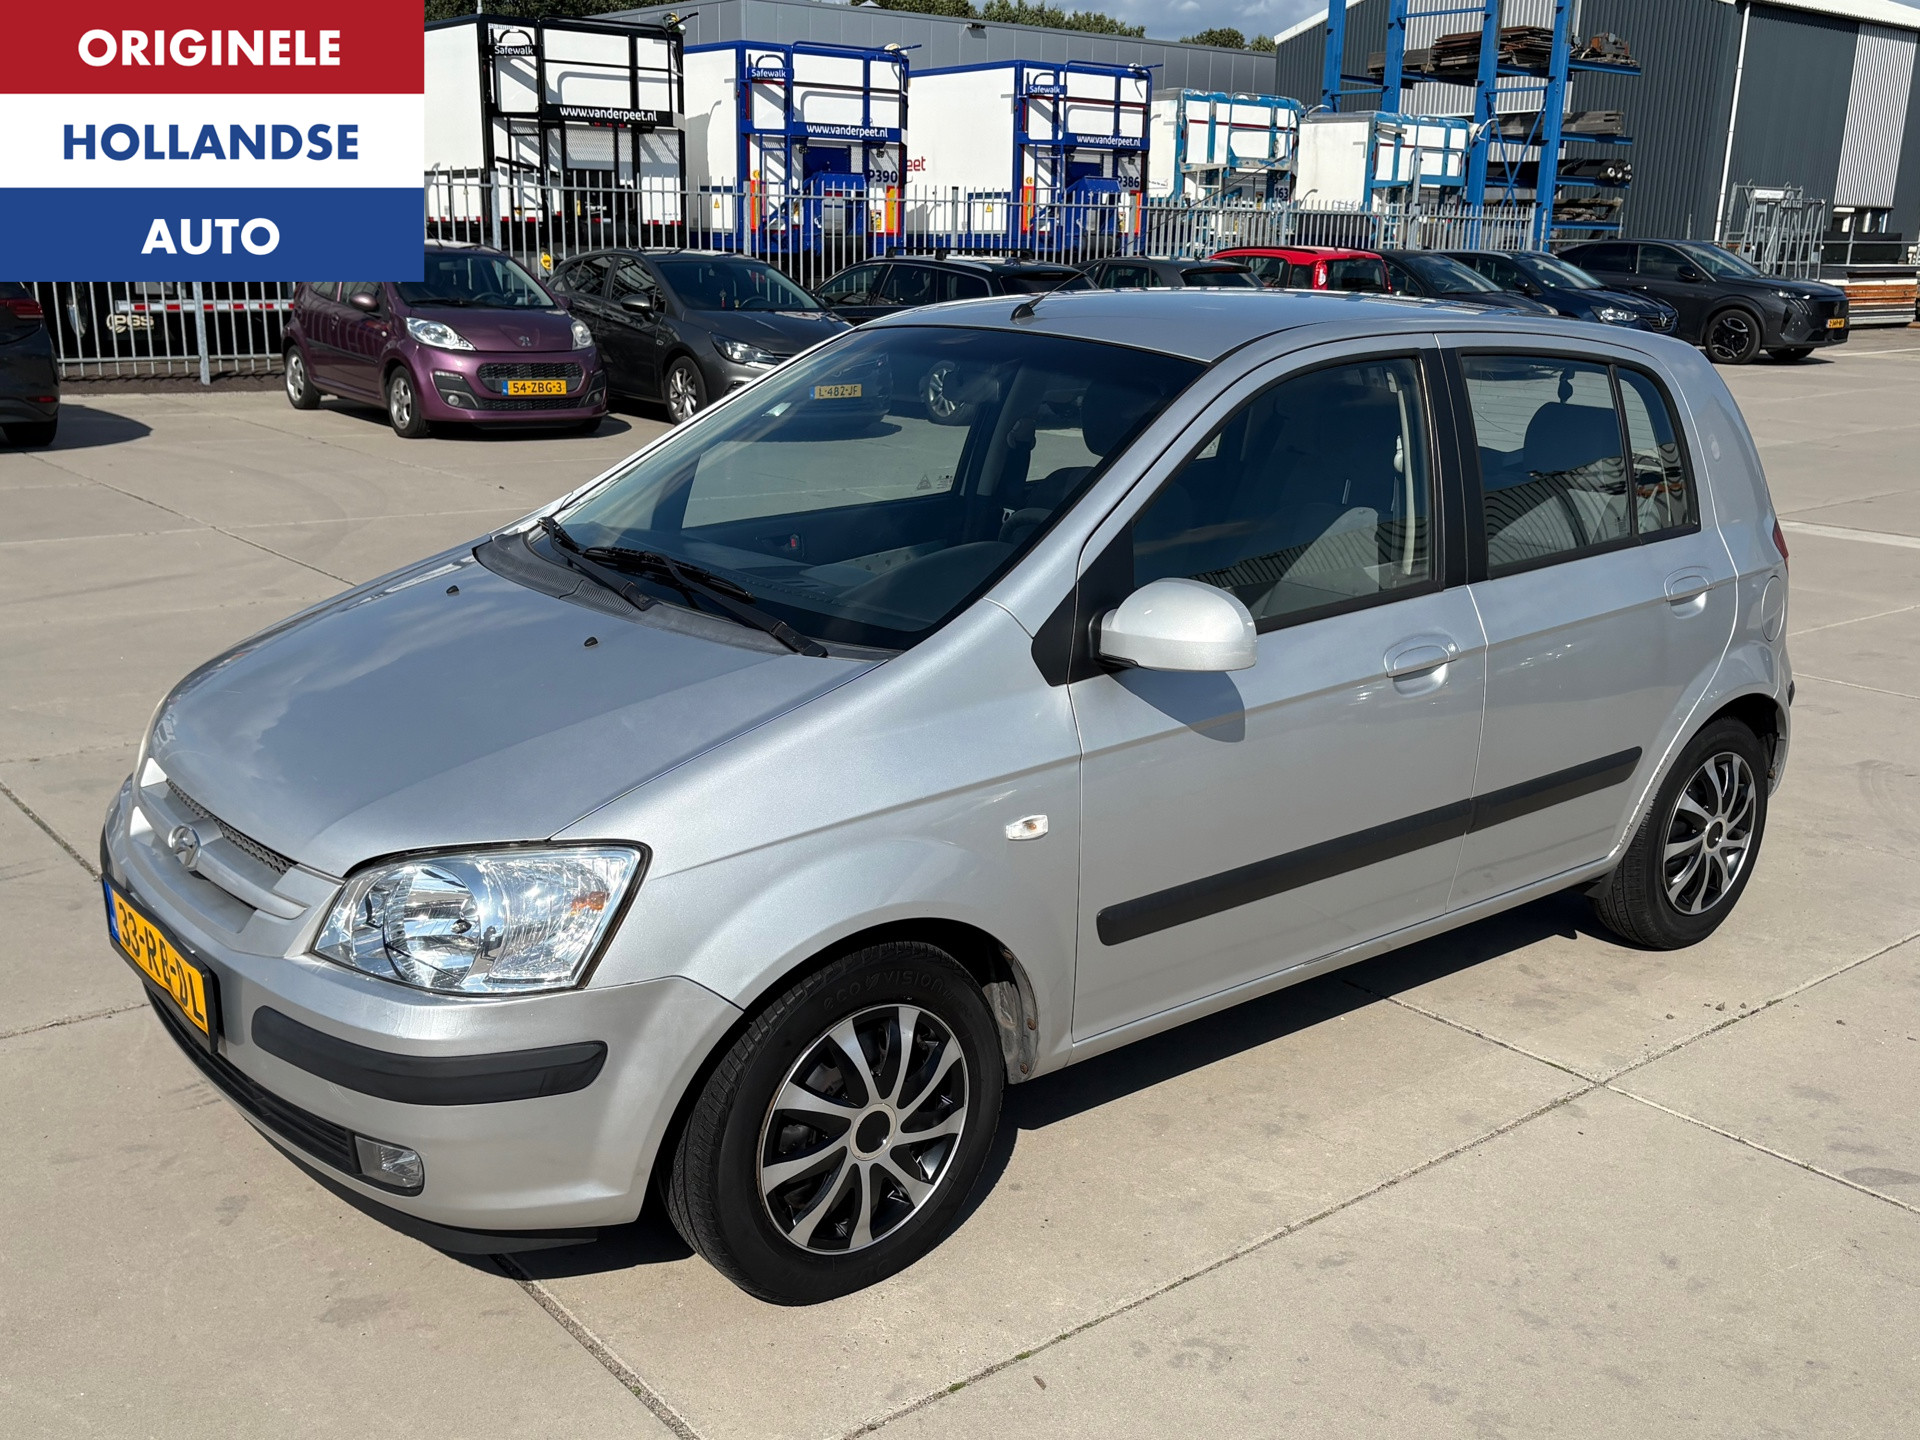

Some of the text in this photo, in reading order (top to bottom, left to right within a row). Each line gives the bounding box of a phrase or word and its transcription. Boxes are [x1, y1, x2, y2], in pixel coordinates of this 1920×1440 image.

[494, 45, 534, 56] Safewalk
[751, 68, 786, 78] Safewalk
[1029, 85, 1061, 94] Safewalk
[560, 106, 658, 122] www.vanderpeet.nl
[806, 124, 888, 138] www.vanderpeet.nl
[1076, 135, 1141, 147] www.vanderpeet.nl
[906, 155, 926, 172] eet
[869, 169, 898, 183] P390
[1275, 187, 1289, 199] 163
[512, 382, 563, 394] 54-ZBG-3
[818, 385, 858, 397] L-482-JF
[119, 901, 205, 1024] 33-RB-DL
